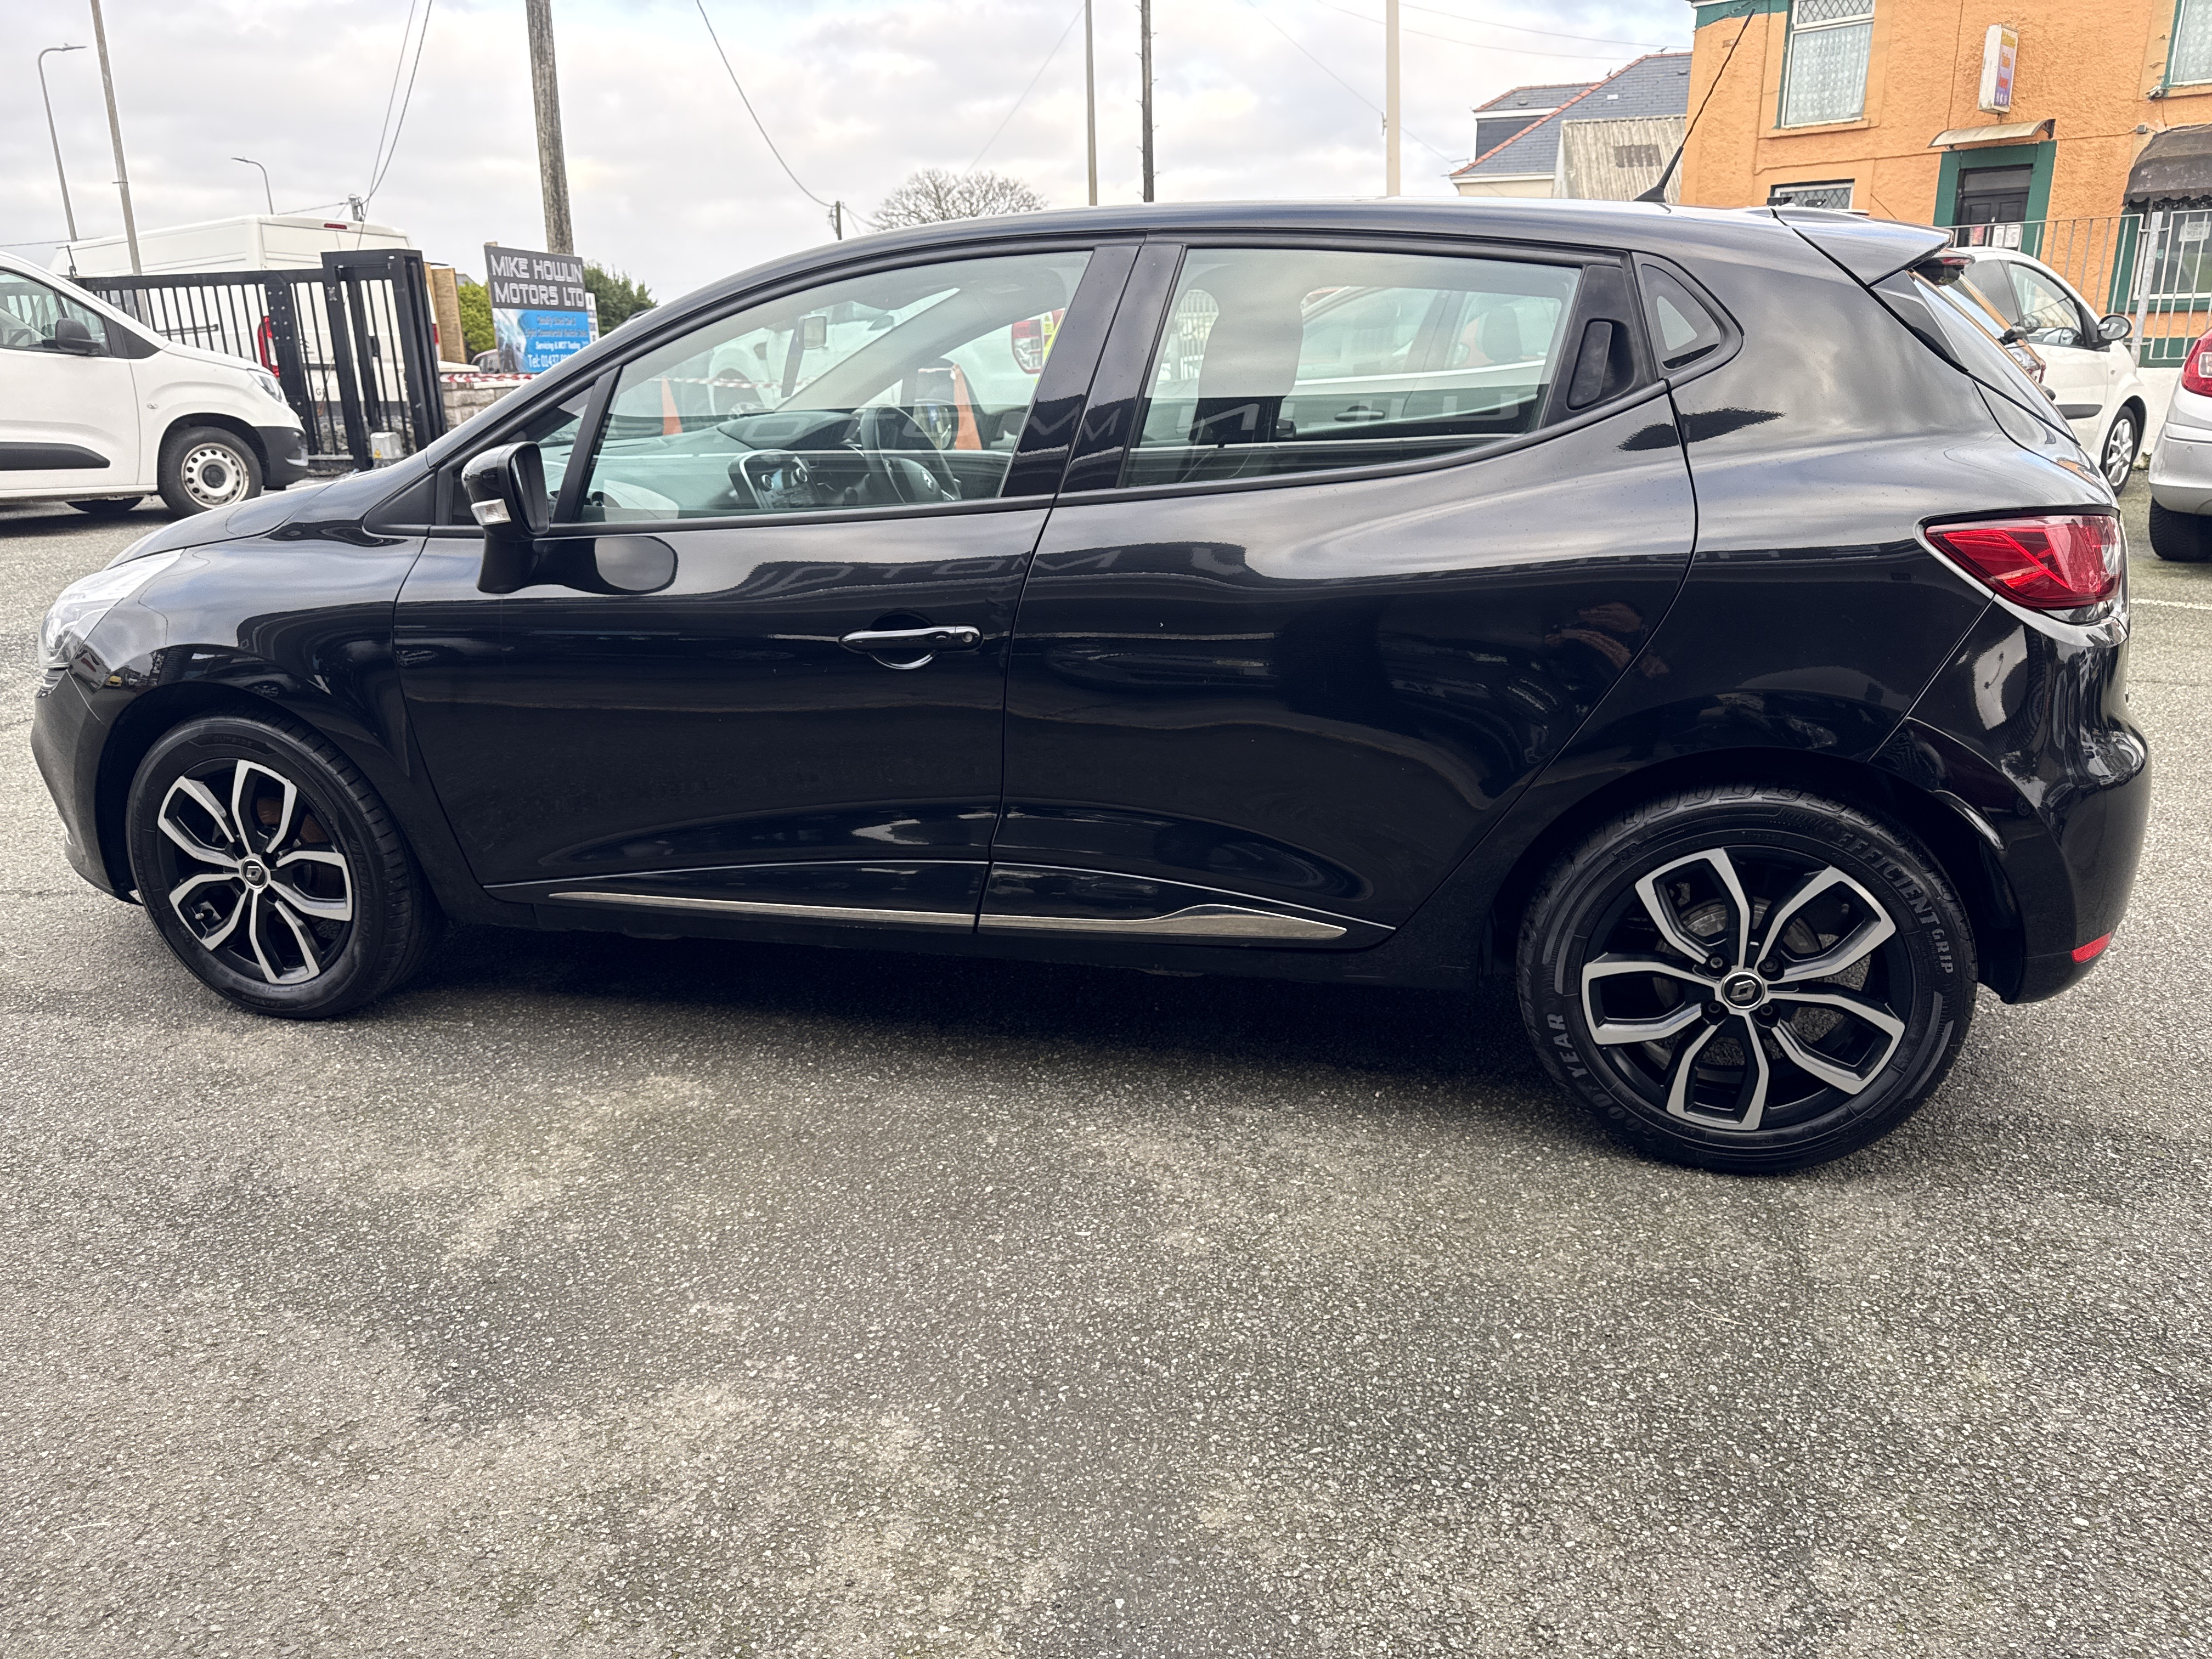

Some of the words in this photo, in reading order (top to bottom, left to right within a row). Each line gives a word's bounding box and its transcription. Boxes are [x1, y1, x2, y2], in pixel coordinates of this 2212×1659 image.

[490, 254, 530, 279] MIKE
[533, 259, 583, 284] HOWLIN
[494, 281, 559, 306] MOTORS
[562, 286, 585, 307] LTD
[1831, 833, 1940, 925] EFFICIENT
[1932, 928, 1954, 974] GRIP
[1548, 1014, 1588, 1079] YEAR
